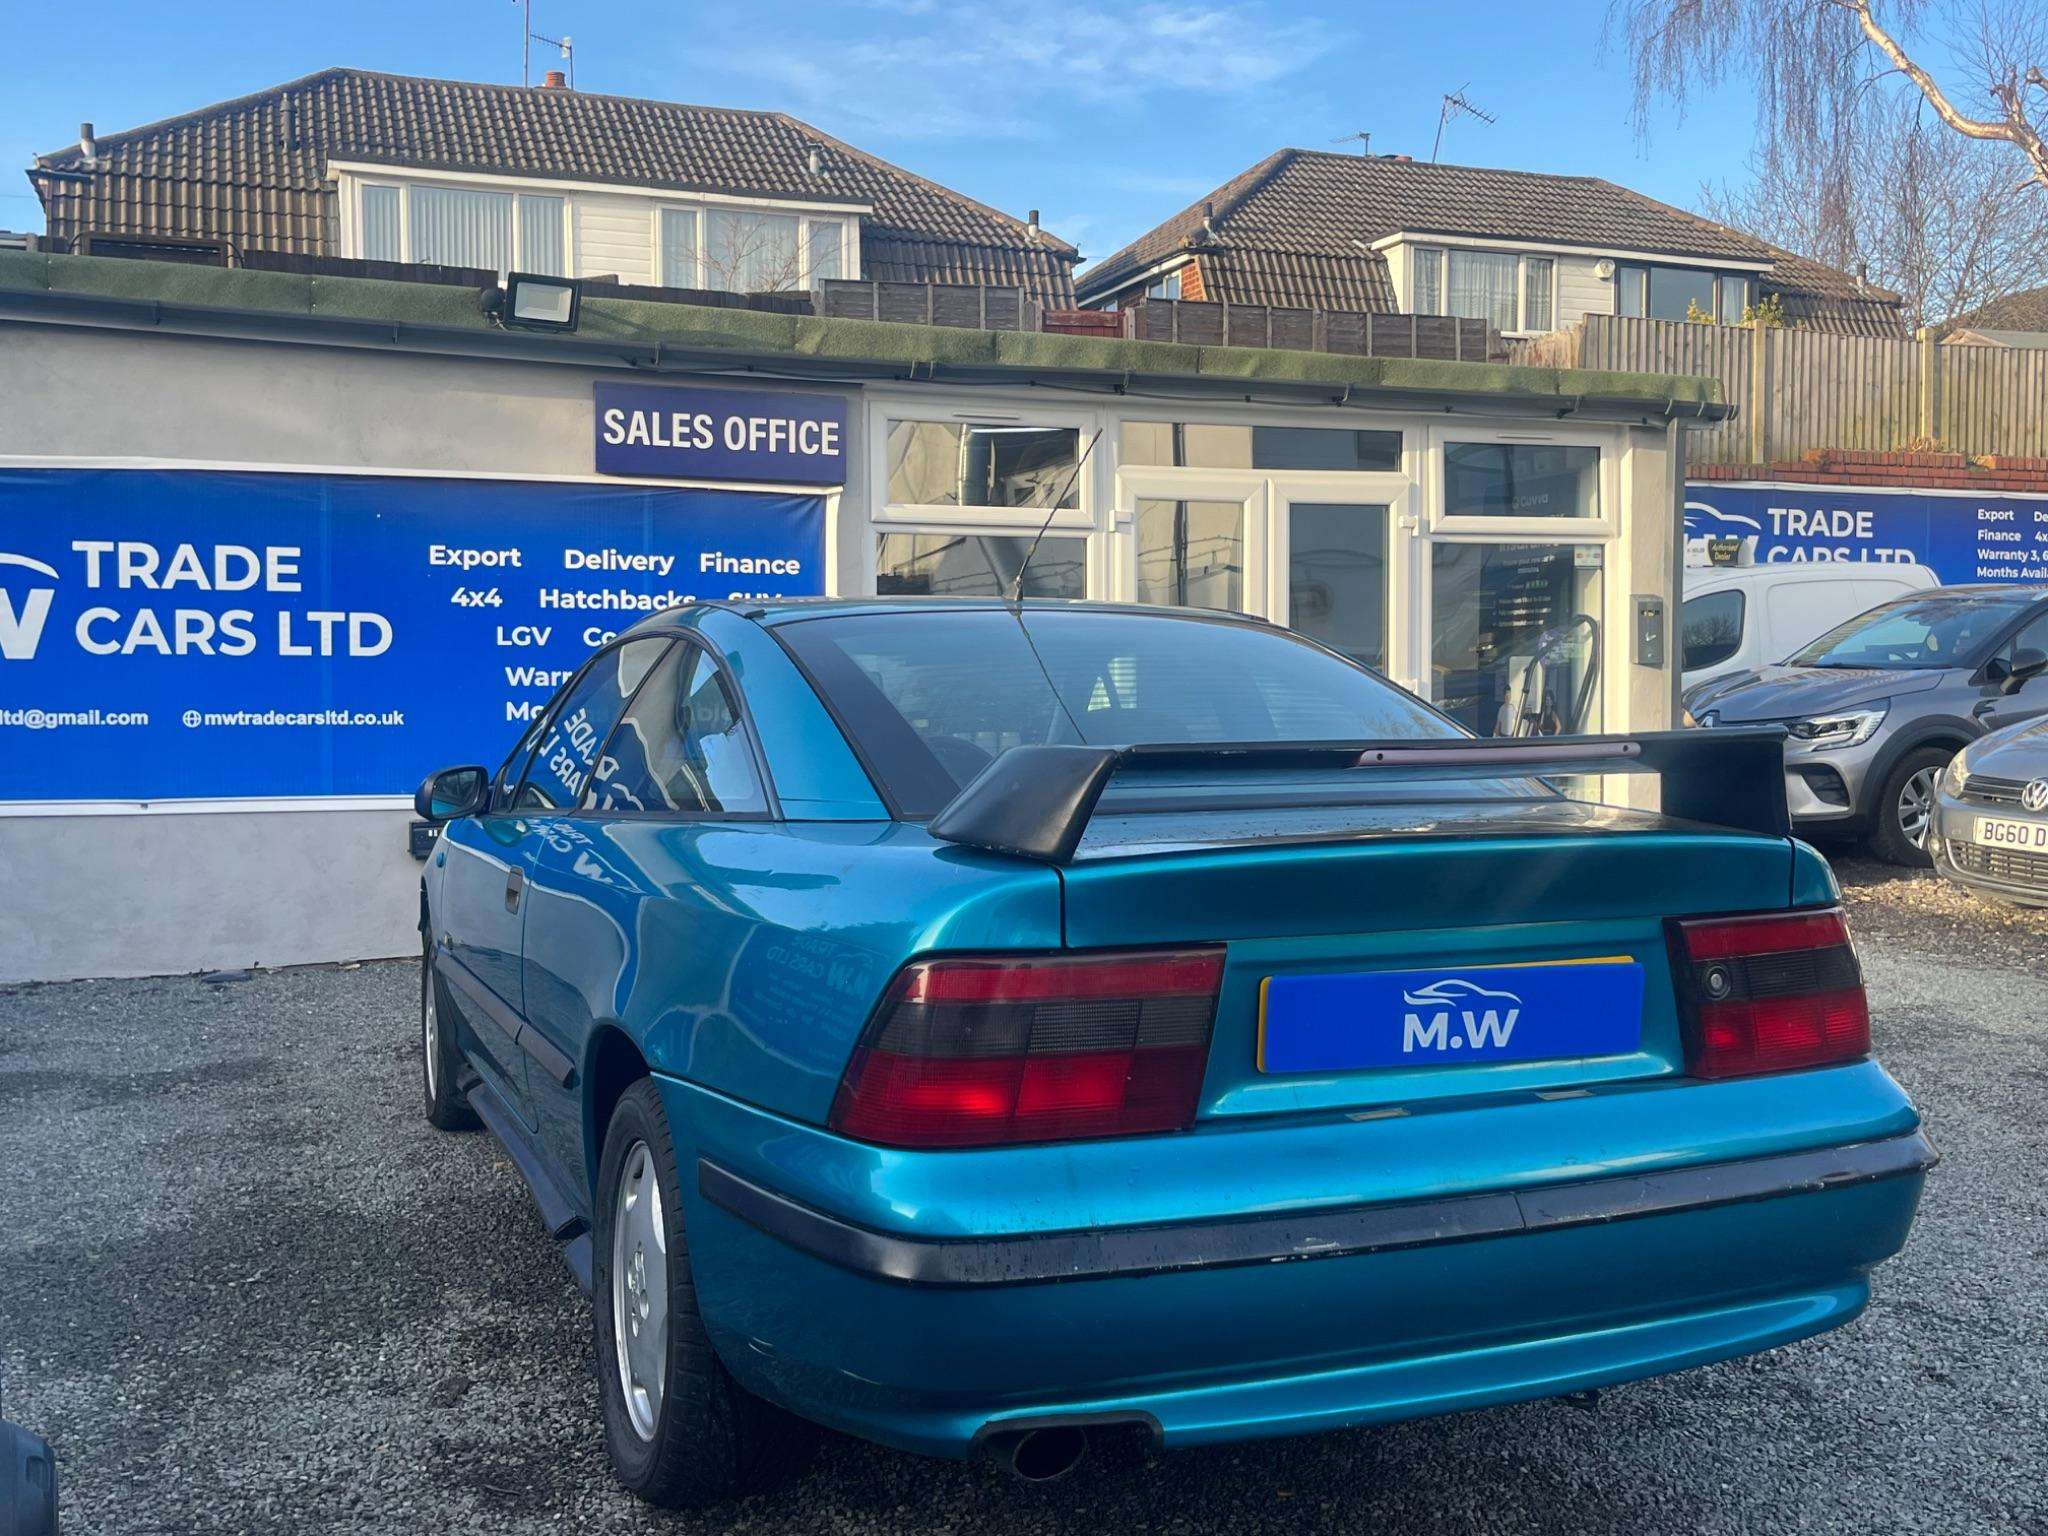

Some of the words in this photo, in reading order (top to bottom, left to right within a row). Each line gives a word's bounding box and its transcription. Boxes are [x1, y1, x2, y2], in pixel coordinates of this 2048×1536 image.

[603, 408, 714, 450] SALES
[723, 415, 840, 456] OFFICE
[1767, 507, 1873, 538] TRADE
[1977, 508, 2015, 522] Export
[1977, 528, 2022, 542] Finance
[72, 540, 302, 592] TRADE
[429, 544, 522, 571] Export
[564, 548, 675, 576] Delivery
[700, 552, 800, 575] Finance
[1977, 548, 2029, 563] Warranty
[1976, 566, 2019, 578] Months
[2020, 567, 2048, 578] Avail
[451, 587, 503, 608] 4x4
[540, 588, 696, 611] Hatchbacks
[75, 607, 257, 657] CARS
[278, 611, 393, 657] LTD
[496, 625, 553, 647] LGV
[204, 709, 405, 727] mwtradecarsltd.co.uk
[1983, 821, 2029, 845] BG60
[1403, 1008, 1520, 1053] M.W
